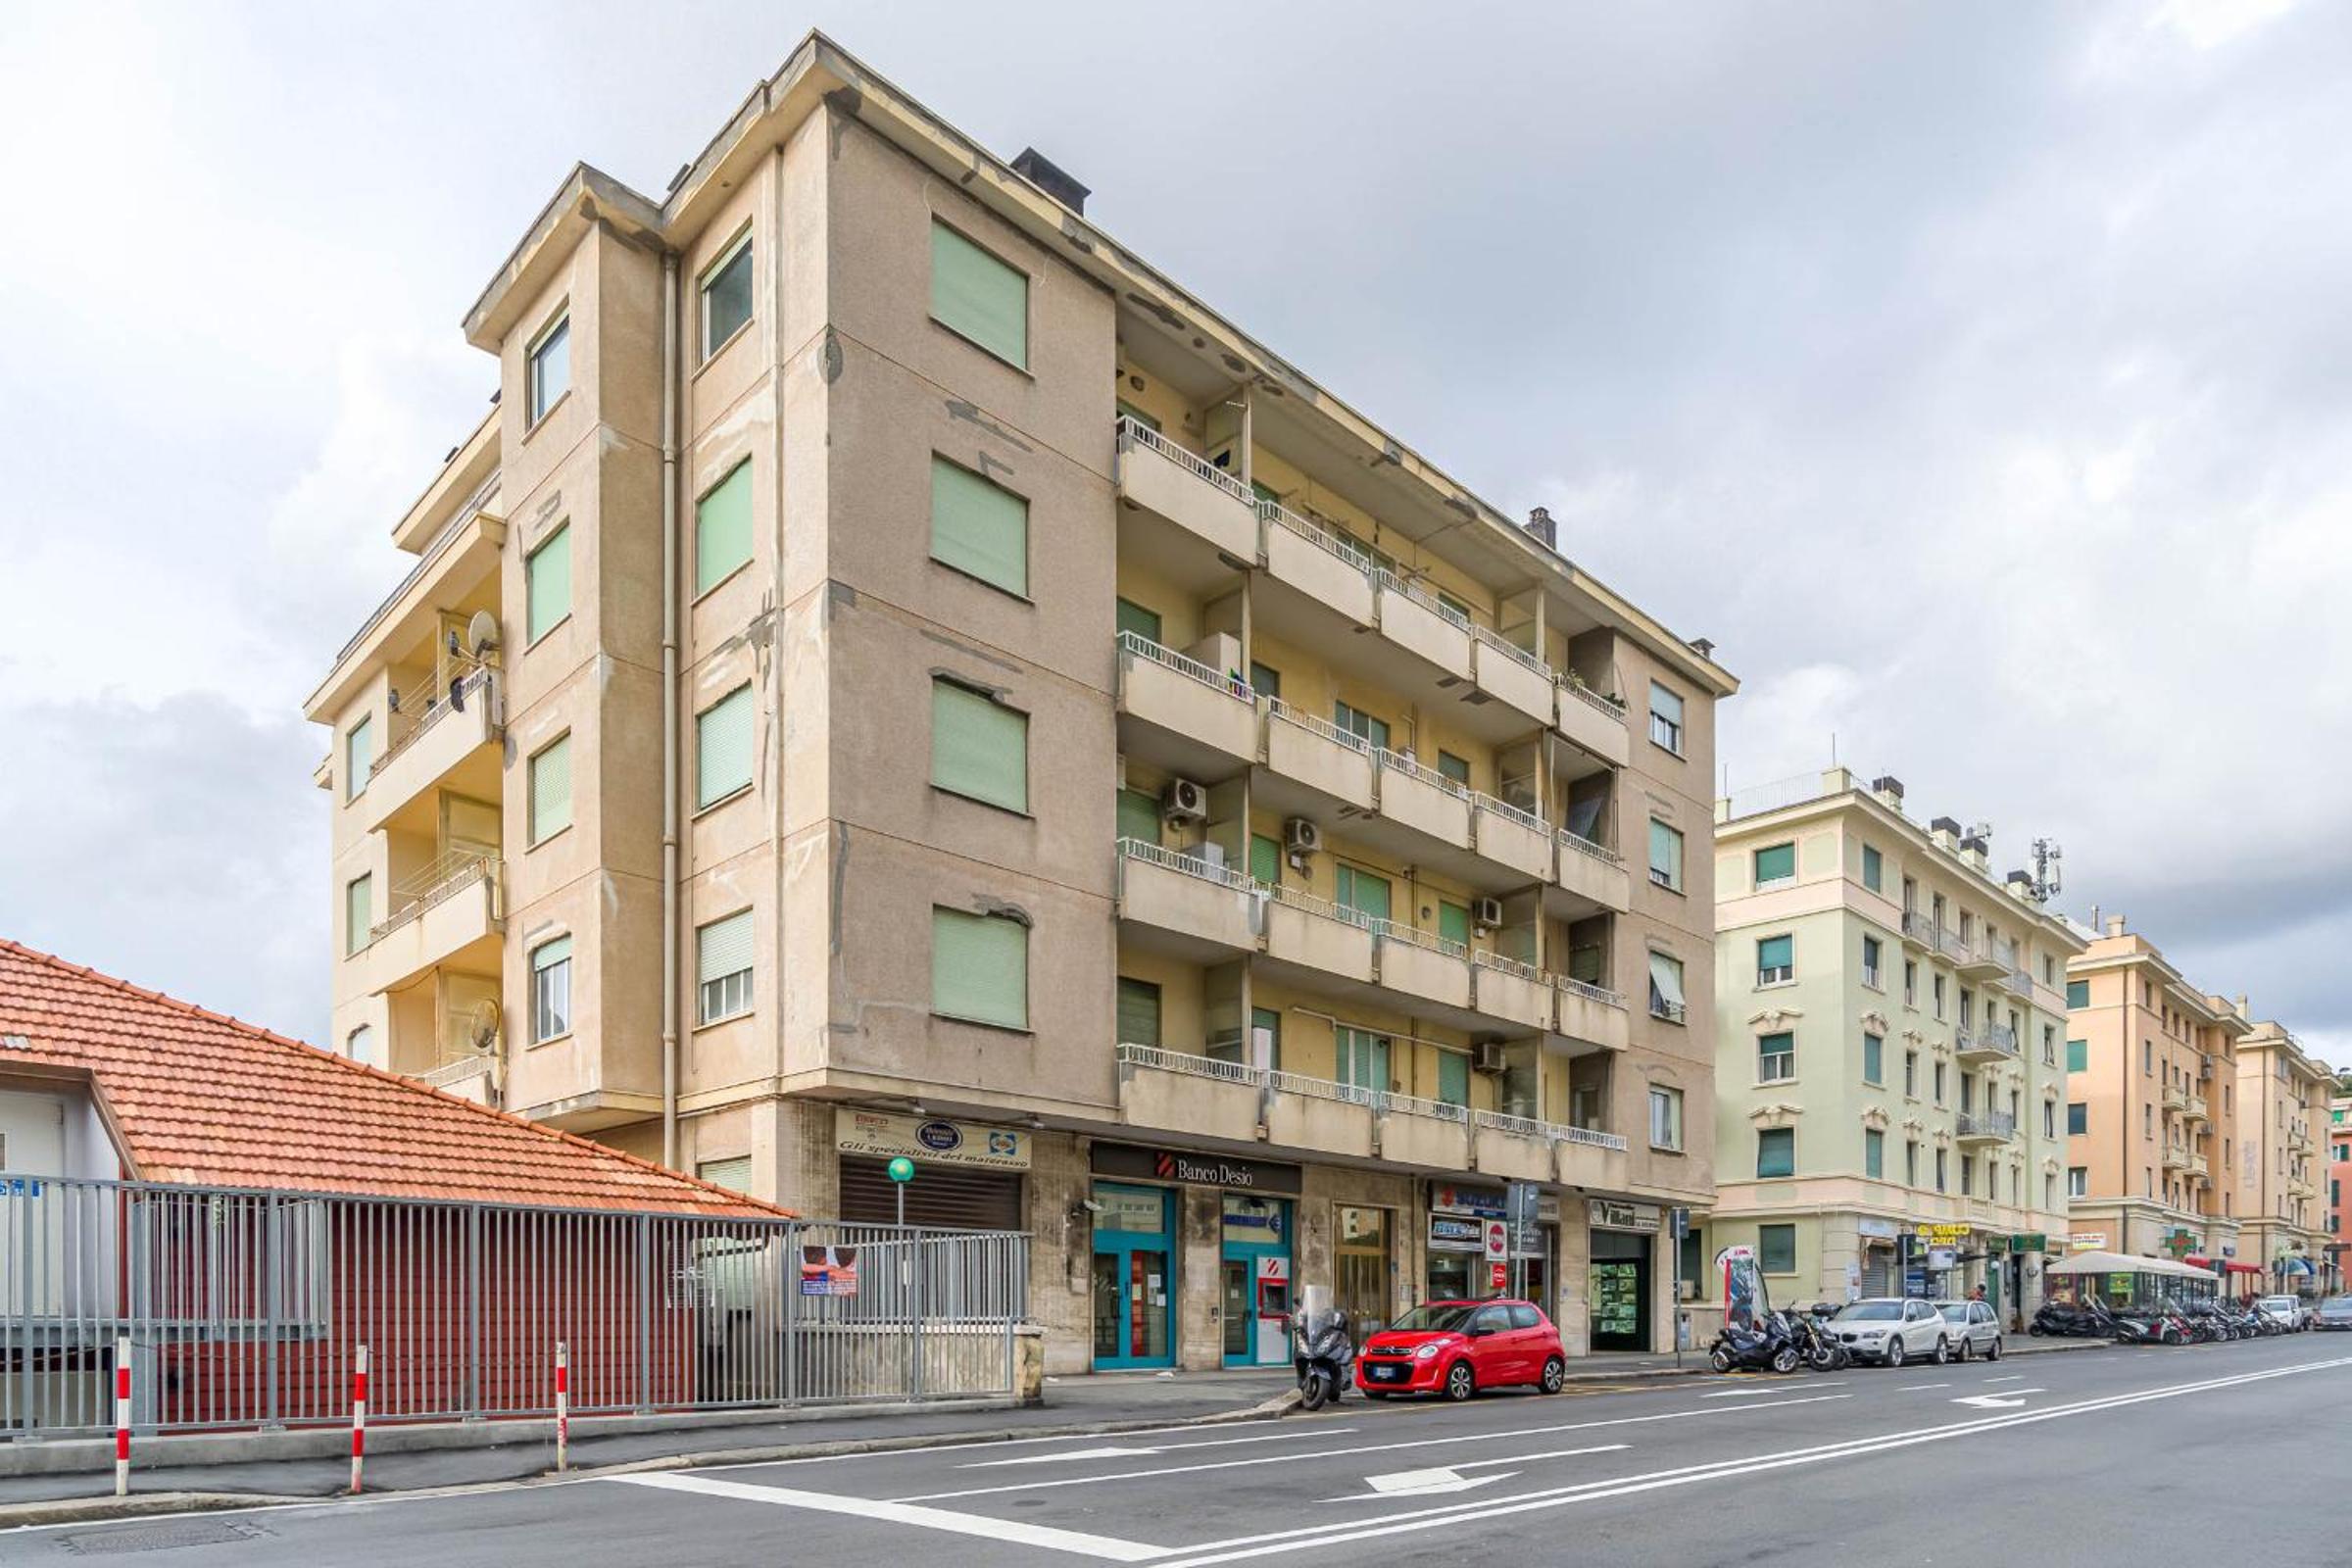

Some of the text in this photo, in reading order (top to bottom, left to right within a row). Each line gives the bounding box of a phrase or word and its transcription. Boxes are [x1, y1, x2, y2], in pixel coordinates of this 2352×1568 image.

[840, 1141, 864, 1152] Gli
[868, 1145, 940, 1158] specialisti
[964, 1155, 1028, 1168] materasso
[1178, 1159, 1253, 1186] Banco Desio
[1455, 1191, 1506, 1209] SUZUKI
